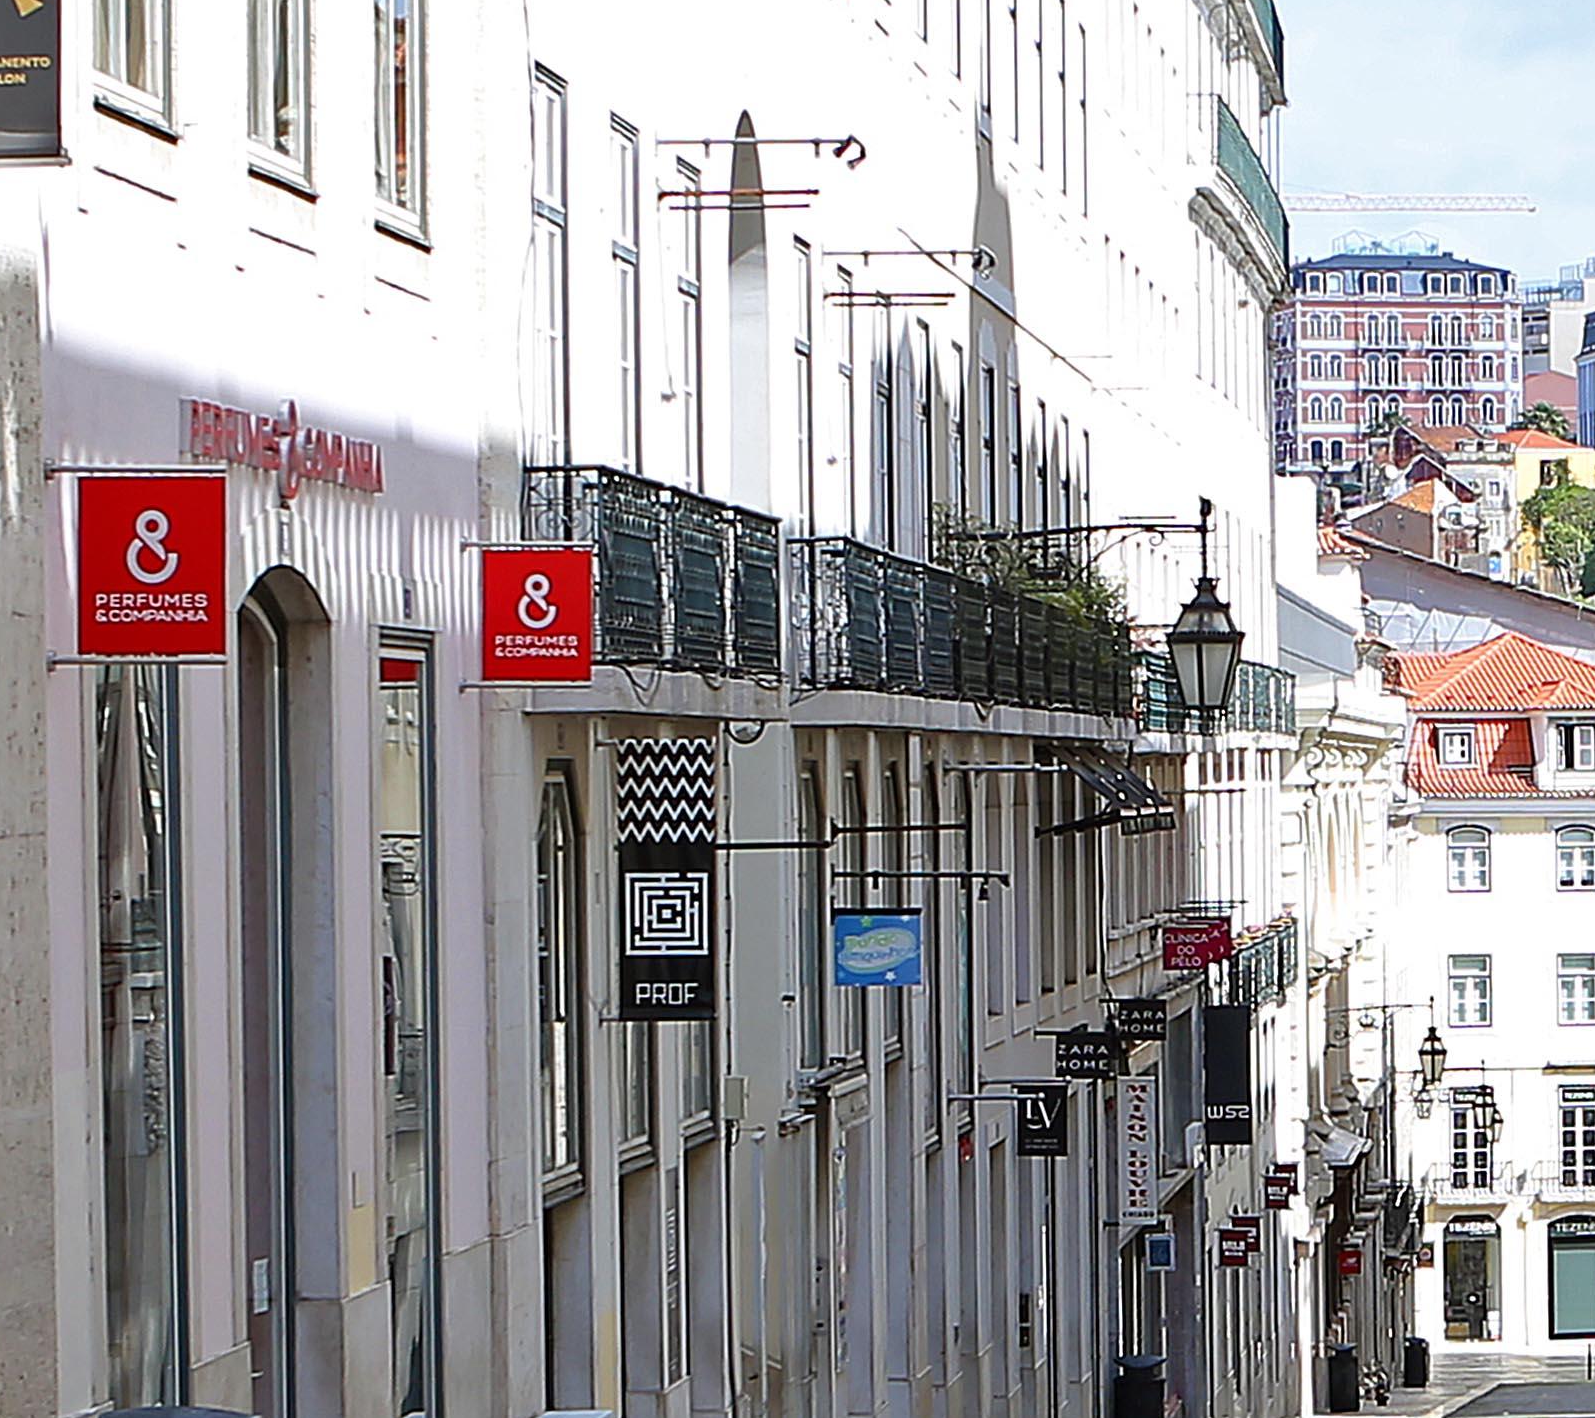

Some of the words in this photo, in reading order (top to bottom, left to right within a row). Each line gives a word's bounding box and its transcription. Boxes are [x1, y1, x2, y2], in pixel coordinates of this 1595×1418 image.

[95, 593, 208, 607] PERFUMES
[495, 635, 578, 646] PERFUMES
[1177, 945, 1195, 955] DO
[636, 983, 698, 1005] PROF
[1120, 1010, 1165, 1020] ZARA
[1118, 1024, 1165, 1033] HOME
[1058, 1044, 1109, 1055] ZARA
[1056, 1060, 1108, 1070] HOME
